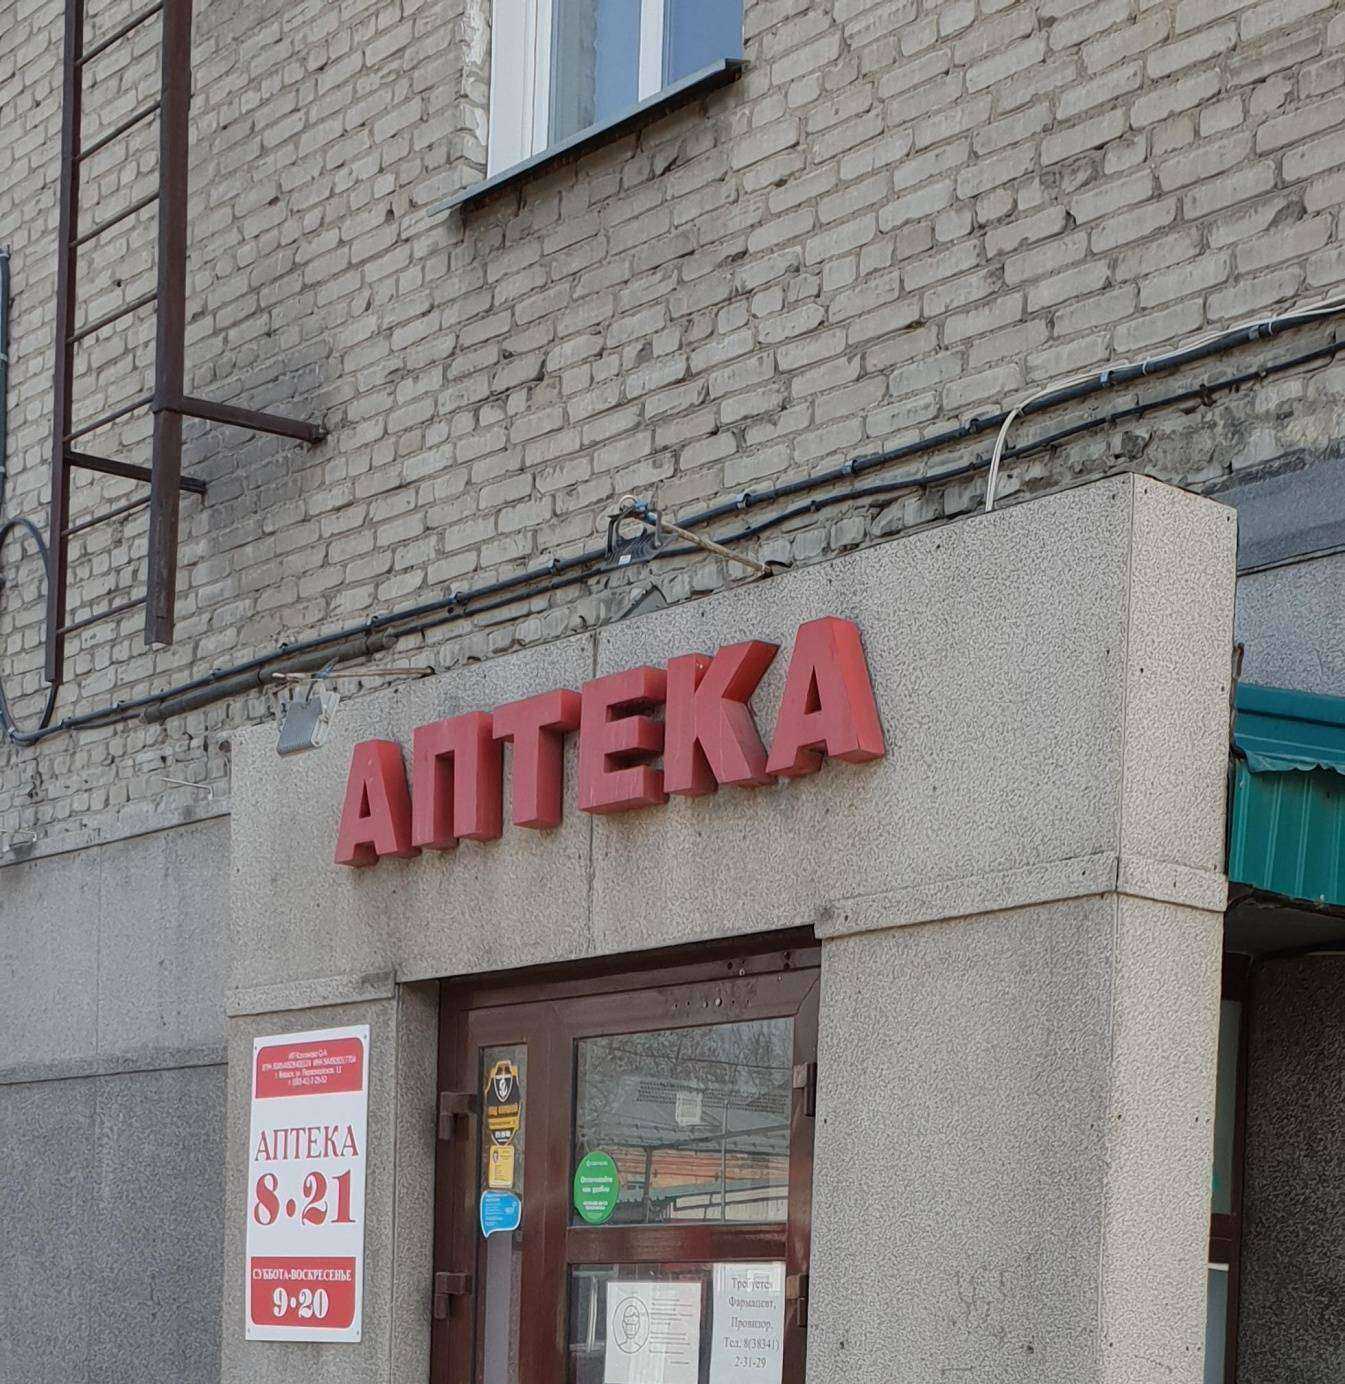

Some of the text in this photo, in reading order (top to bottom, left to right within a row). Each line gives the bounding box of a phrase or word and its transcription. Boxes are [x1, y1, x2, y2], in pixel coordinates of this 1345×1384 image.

[334, 615, 884, 868] АПТЕКА
[253, 1123, 359, 1162] АПТЕКА
[252, 1267, 352, 1282] СУББОТА-ВОСКРЕСЕНЬЕ
[731, 1277, 773, 1290] Треуетс
[734, 1356, 767, 1369] 2-31-29
